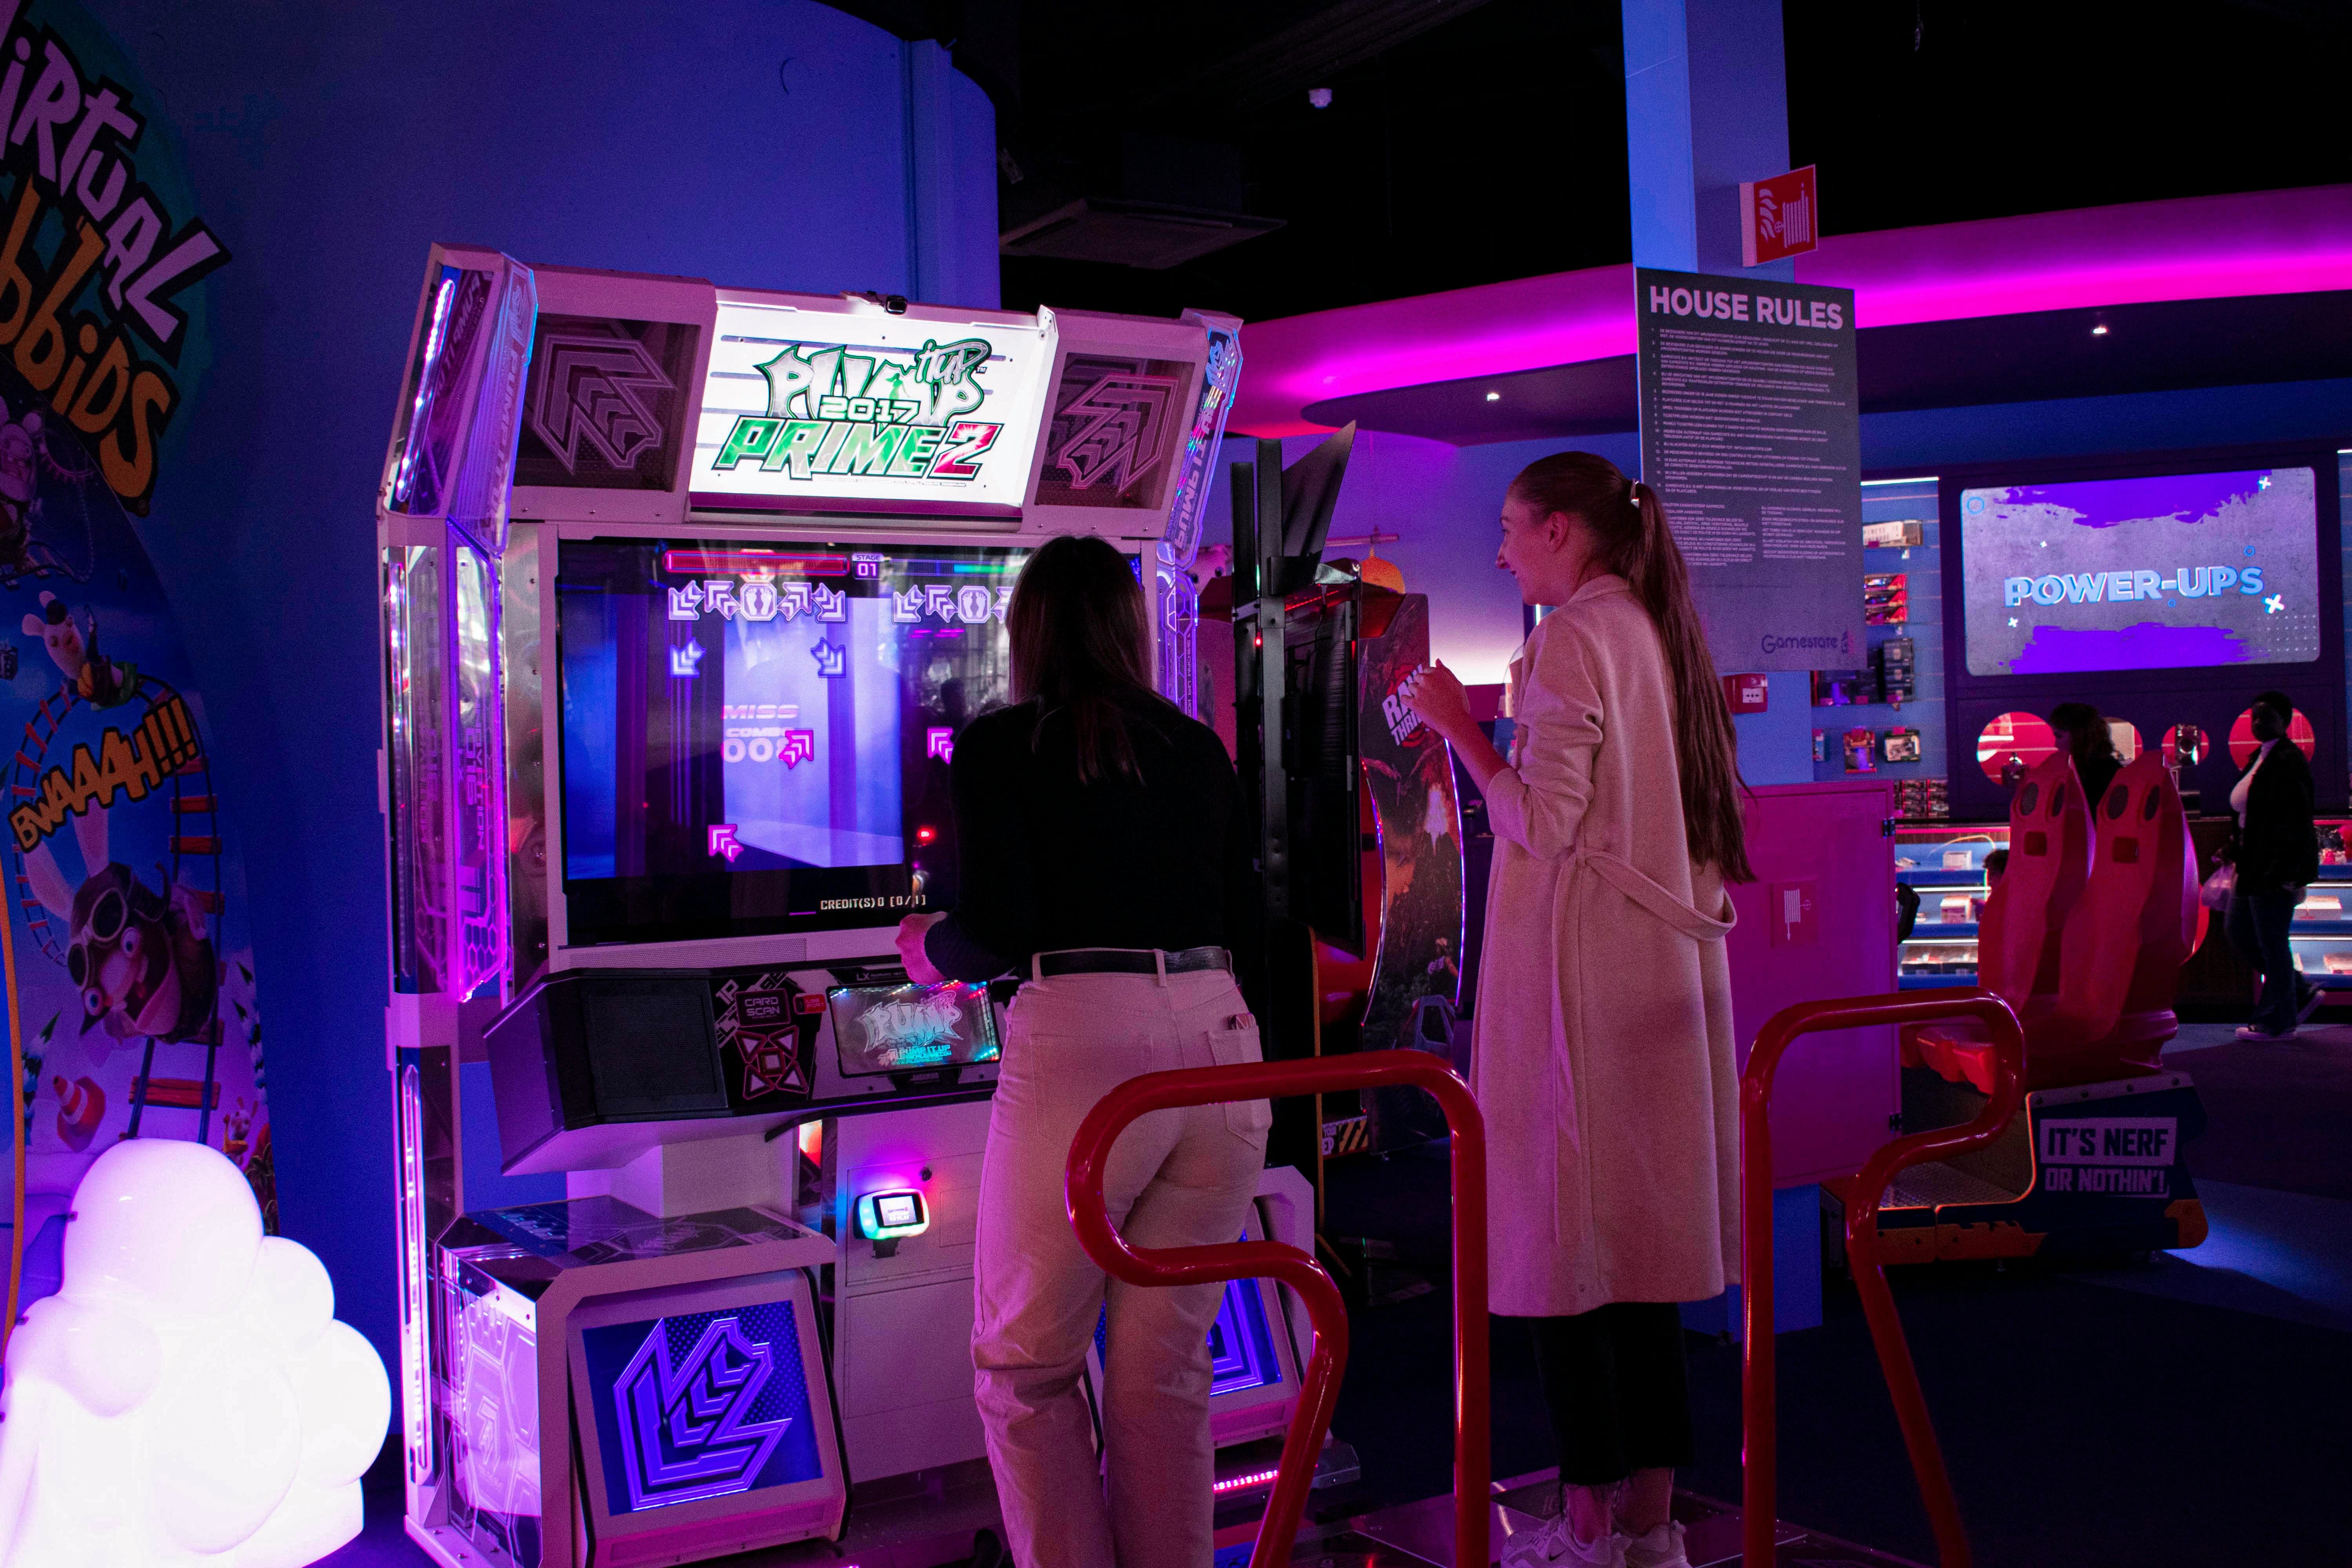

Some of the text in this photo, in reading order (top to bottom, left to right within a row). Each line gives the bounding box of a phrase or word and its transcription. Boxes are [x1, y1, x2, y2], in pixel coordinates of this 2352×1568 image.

[1650, 285, 1844, 330] HOUSE RULES
[755, 343, 985, 427] PUMP
[817, 396, 921, 424] 2017
[713, 416, 1004, 480] PRIME 2
[858, 563, 877, 576] 01
[2004, 566, 2265, 608] POWER-UPS
[1761, 634, 1838, 654] Gamestate
[722, 704, 798, 719] MISS
[726, 727, 795, 737] COMB
[820, 898, 875, 910] CREDIT(S)
[878, 897, 884, 906] 0
[744, 996, 779, 1007] CARD
[746, 1005, 780, 1016] SCAN
[2049, 1128, 2168, 1156] IT'S NERF
[2045, 1167, 2073, 1192] OR
